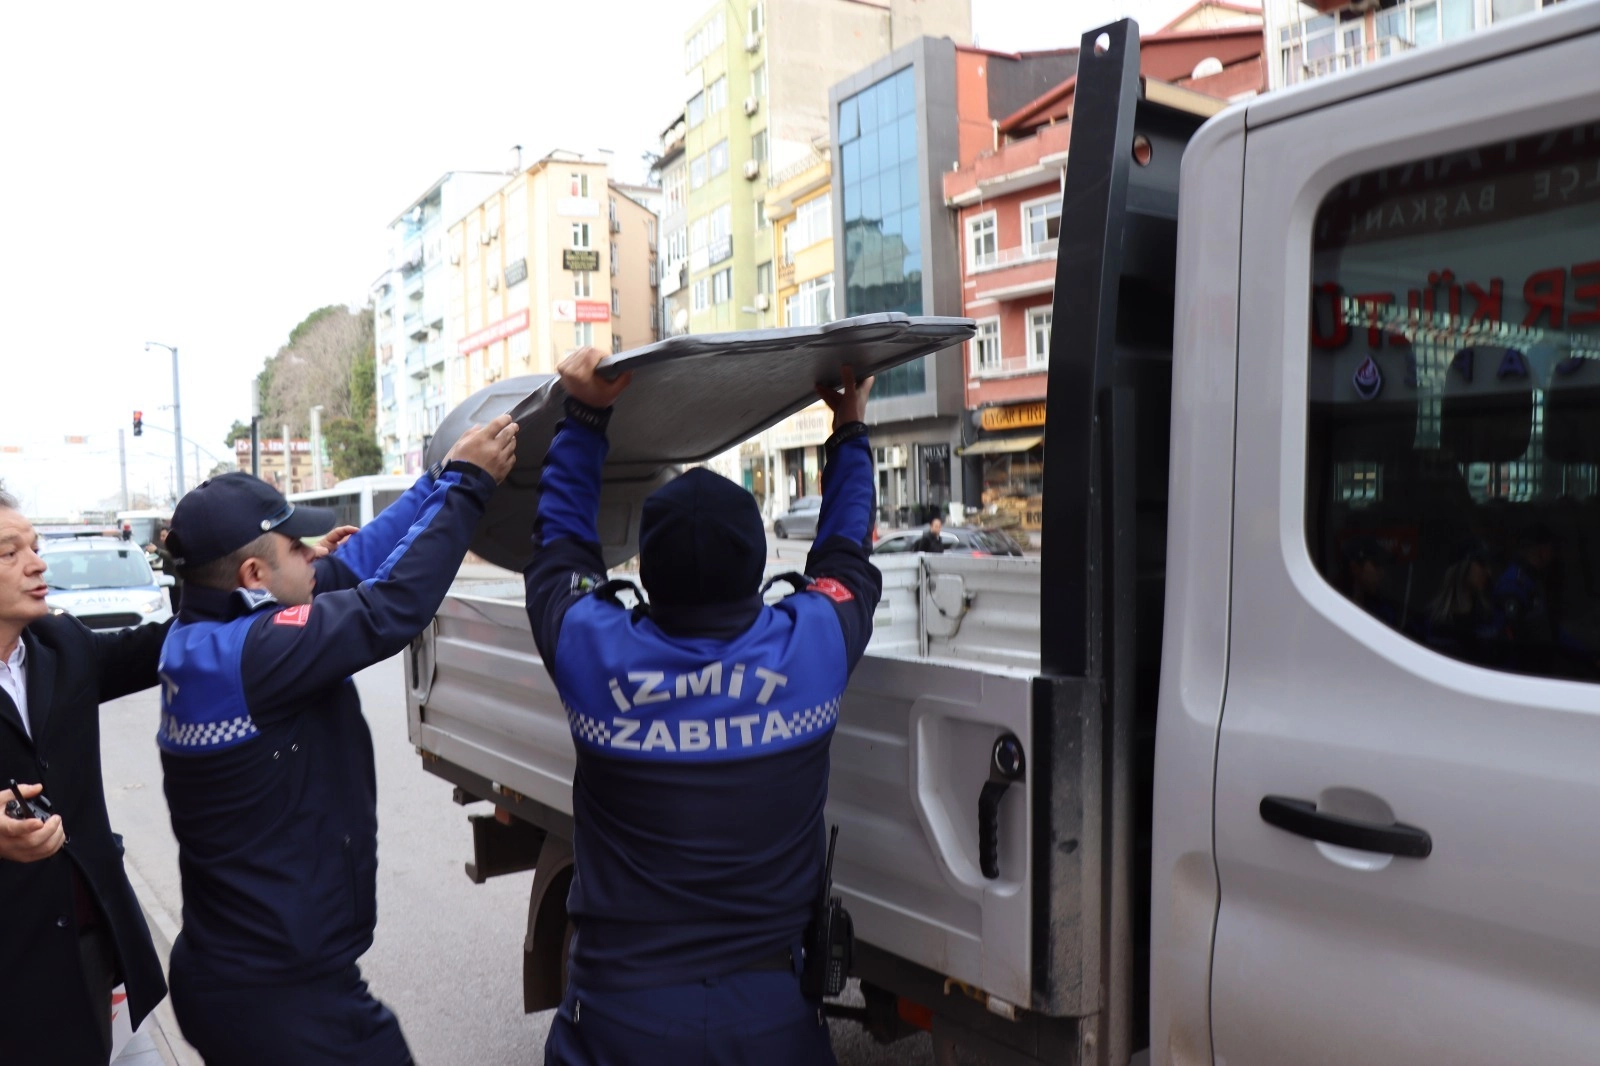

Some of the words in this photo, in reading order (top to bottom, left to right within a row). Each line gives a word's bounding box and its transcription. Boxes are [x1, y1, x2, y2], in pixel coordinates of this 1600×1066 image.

[74, 596, 131, 606] ZABITA
[608, 661, 788, 713] İZMİT
[610, 709, 793, 752] ZABITA
